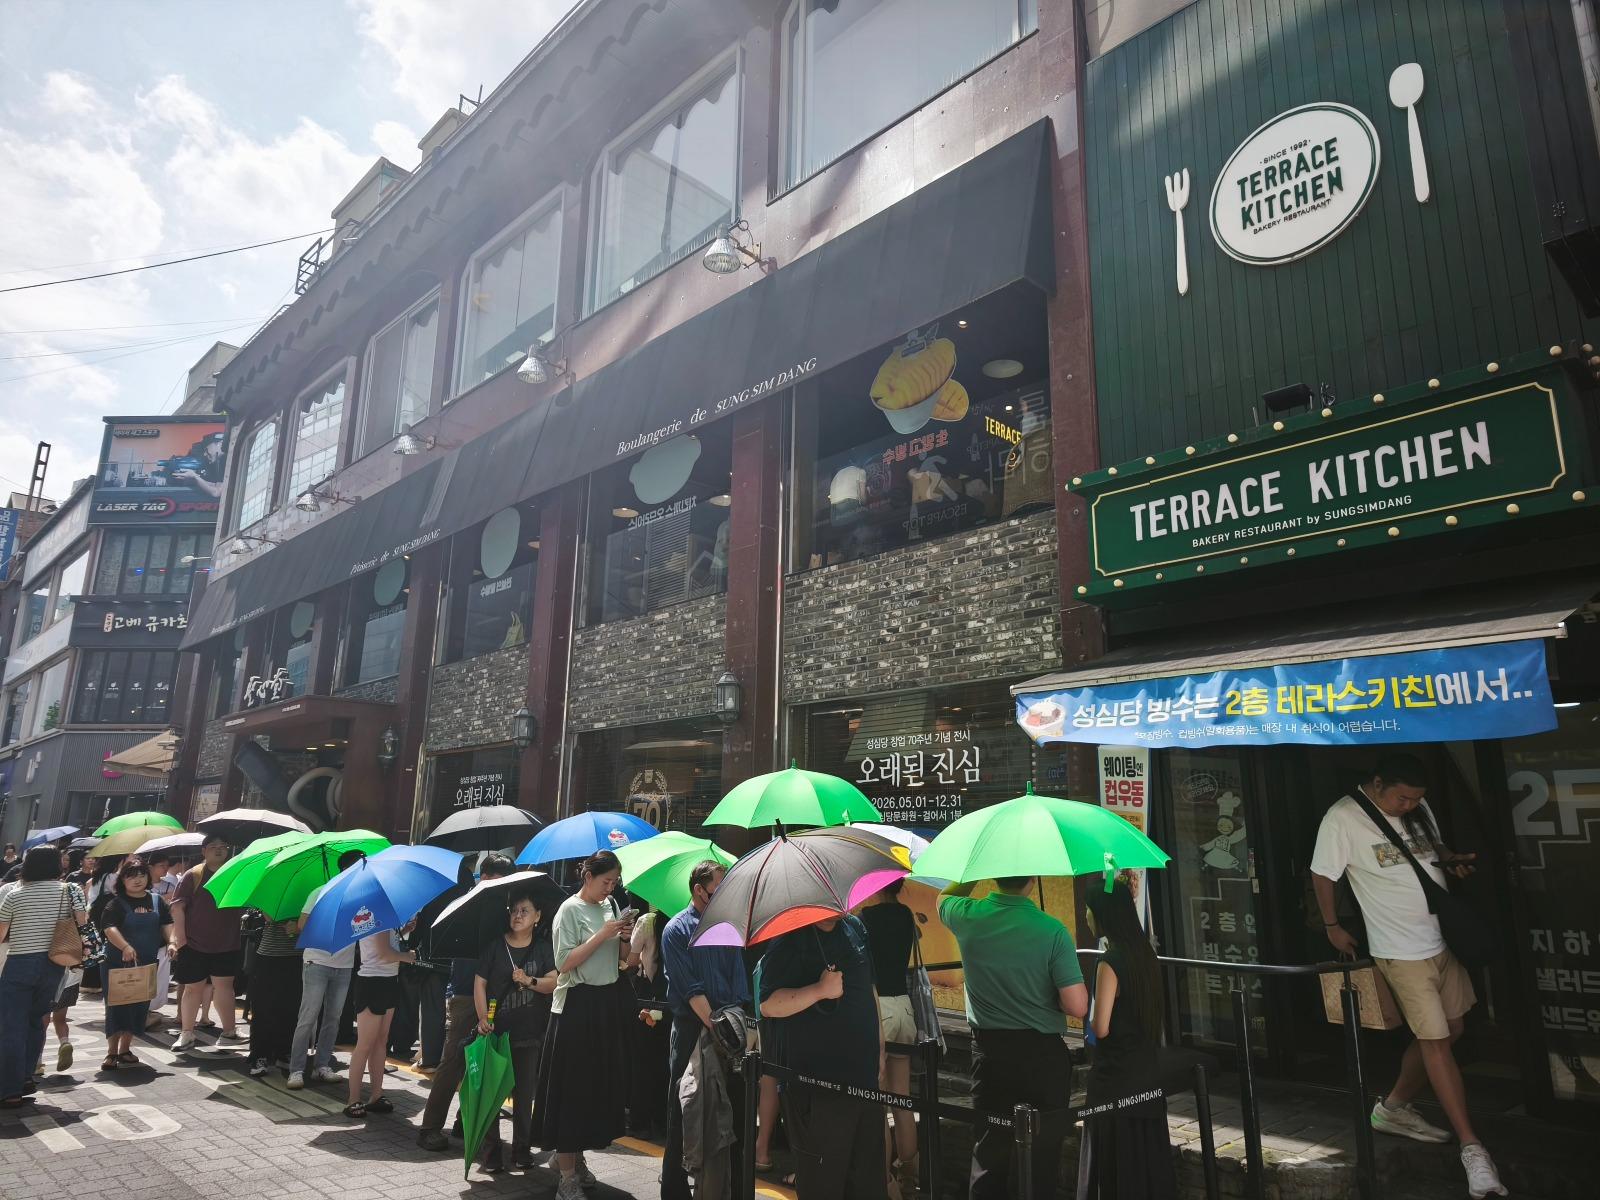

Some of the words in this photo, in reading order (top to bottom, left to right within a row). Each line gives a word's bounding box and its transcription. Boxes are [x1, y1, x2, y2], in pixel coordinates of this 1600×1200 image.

[1264, 148, 1287, 164] SINCE
[1290, 139, 1308, 152] 1992
[1237, 136, 1339, 203] TERRACE
[1241, 166, 1344, 230] KITCHEN
[1253, 218, 1281, 234] BAKERY
[1283, 198, 1331, 222] RESTAURANT
[616, 419, 682, 456] Boulangerie
[690, 408, 707, 424] de
[1130, 470, 1284, 541] TERRACE
[1308, 421, 1492, 504] KITCHEN
[97, 502, 139, 512] LASER
[142, 502, 168, 512] TAG
[1192, 533, 1230, 548] BAKERY
[1234, 517, 1302, 540] RESTAURANT
[1307, 515, 1320, 525] by
[1325, 495, 1413, 520] SUNGSIMDANG
[115, 616, 142, 629] 고베
[1072, 701, 1143, 729] 성심당
[1147, 692, 1220, 723] 빙수는
[1225, 686, 1269, 717] 2층
[866, 736, 889, 749] 성심당
[890, 735, 906, 748] 창업
[907, 732, 933, 746] 70주년
[934, 730, 951, 744] 기념
[953, 729, 971, 742] 전시
[1261, 721, 1282, 733] 매장
[1285, 720, 1297, 734] 내
[1301, 719, 1335, 735] 취식이
[1338, 718, 1402, 734] 어렵습니다.
[856, 750, 925, 788] 오래된
[931, 745, 980, 784] 진심
[454, 785, 483, 808] 오래된
[872, 794, 962, 810] 2026.05.01-12.31
[1104, 779, 1144, 808] 컵우동
[1507, 768, 1600, 836] 2F
[847, 1085, 913, 1108] SUNGSIMDANG
[1117, 1088, 1163, 1109] SUNGSIMDANG
